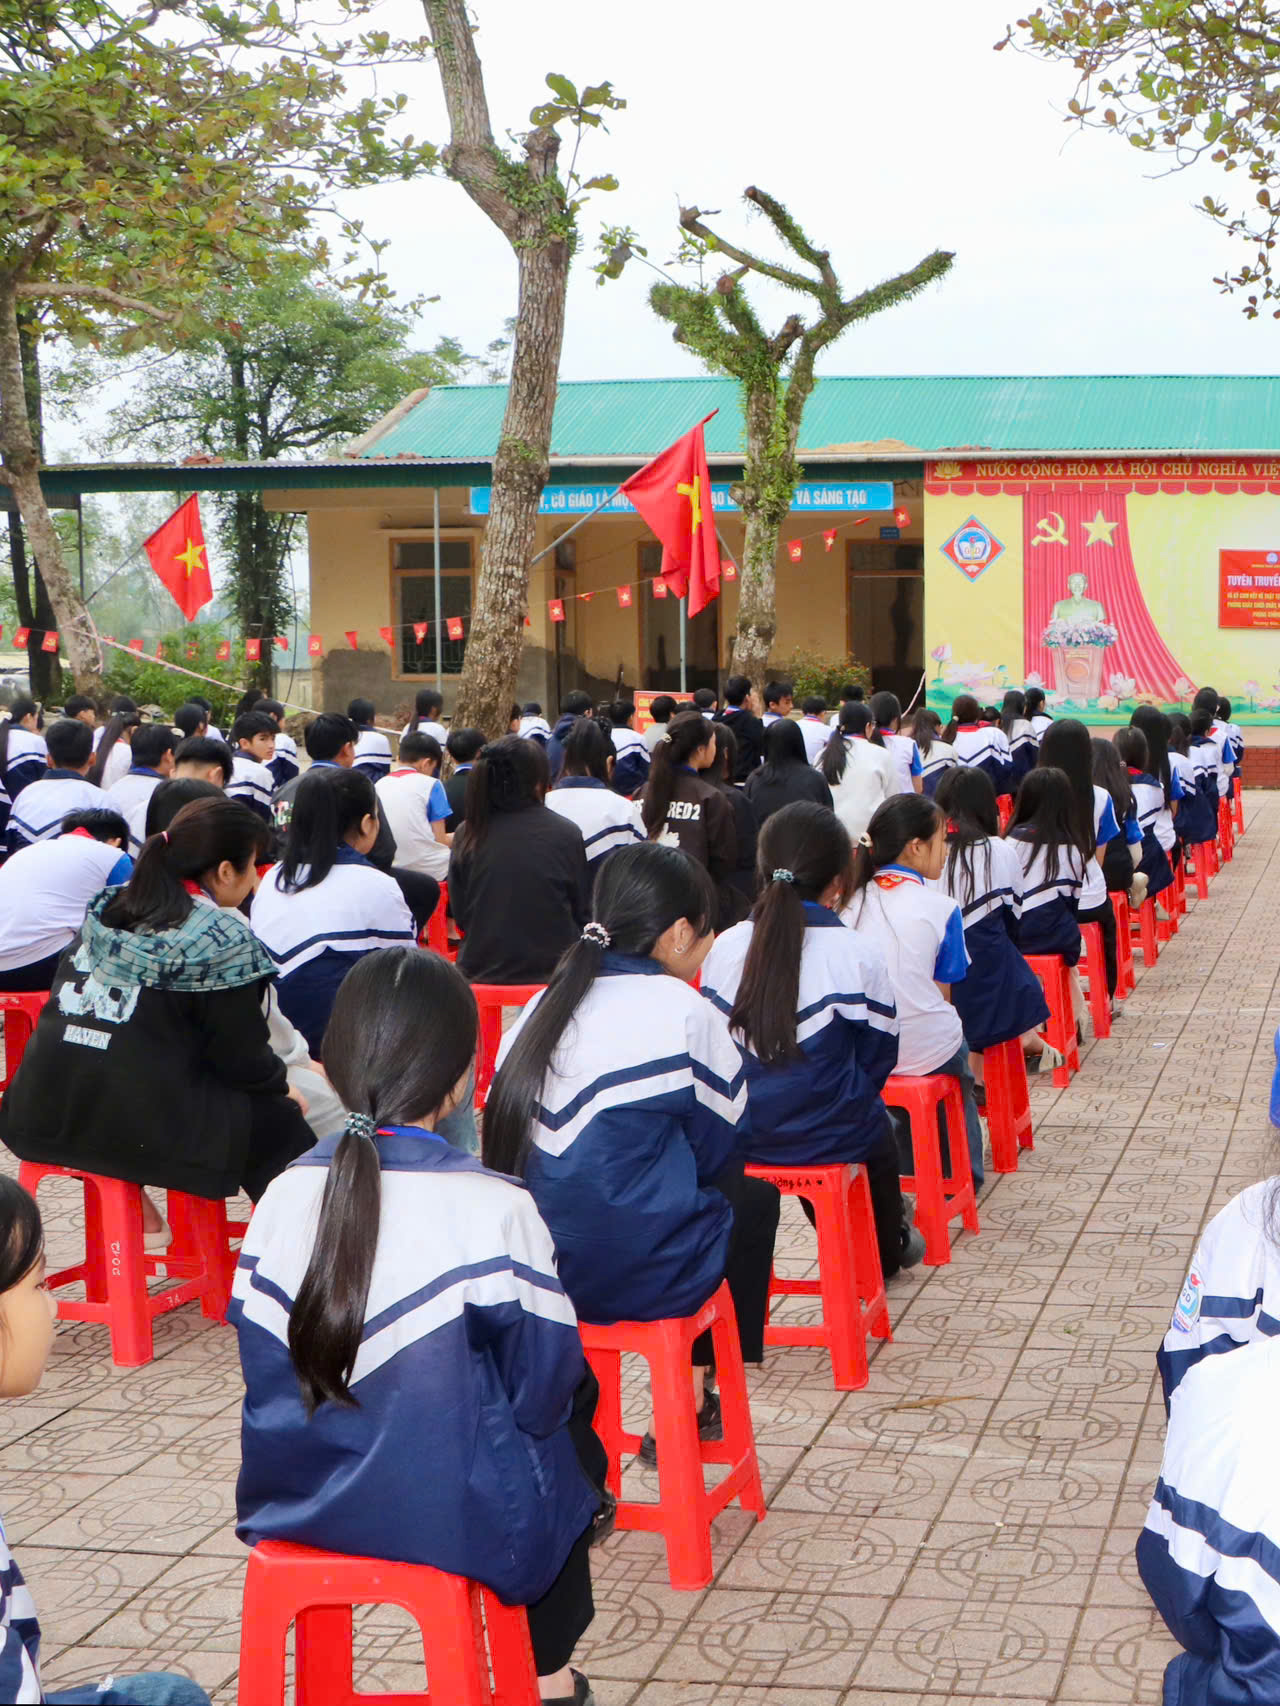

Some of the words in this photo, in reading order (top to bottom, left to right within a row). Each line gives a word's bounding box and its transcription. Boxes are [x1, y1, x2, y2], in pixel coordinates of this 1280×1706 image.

[975, 461, 1017, 477] NƯỚC
[1020, 461, 1064, 479] CỘNG
[1129, 459, 1157, 479] HỘI
[1162, 457, 1193, 477] CHỦ
[1198, 459, 1248, 477] NGHĨA
[111, 1241, 121, 1277] 2012
